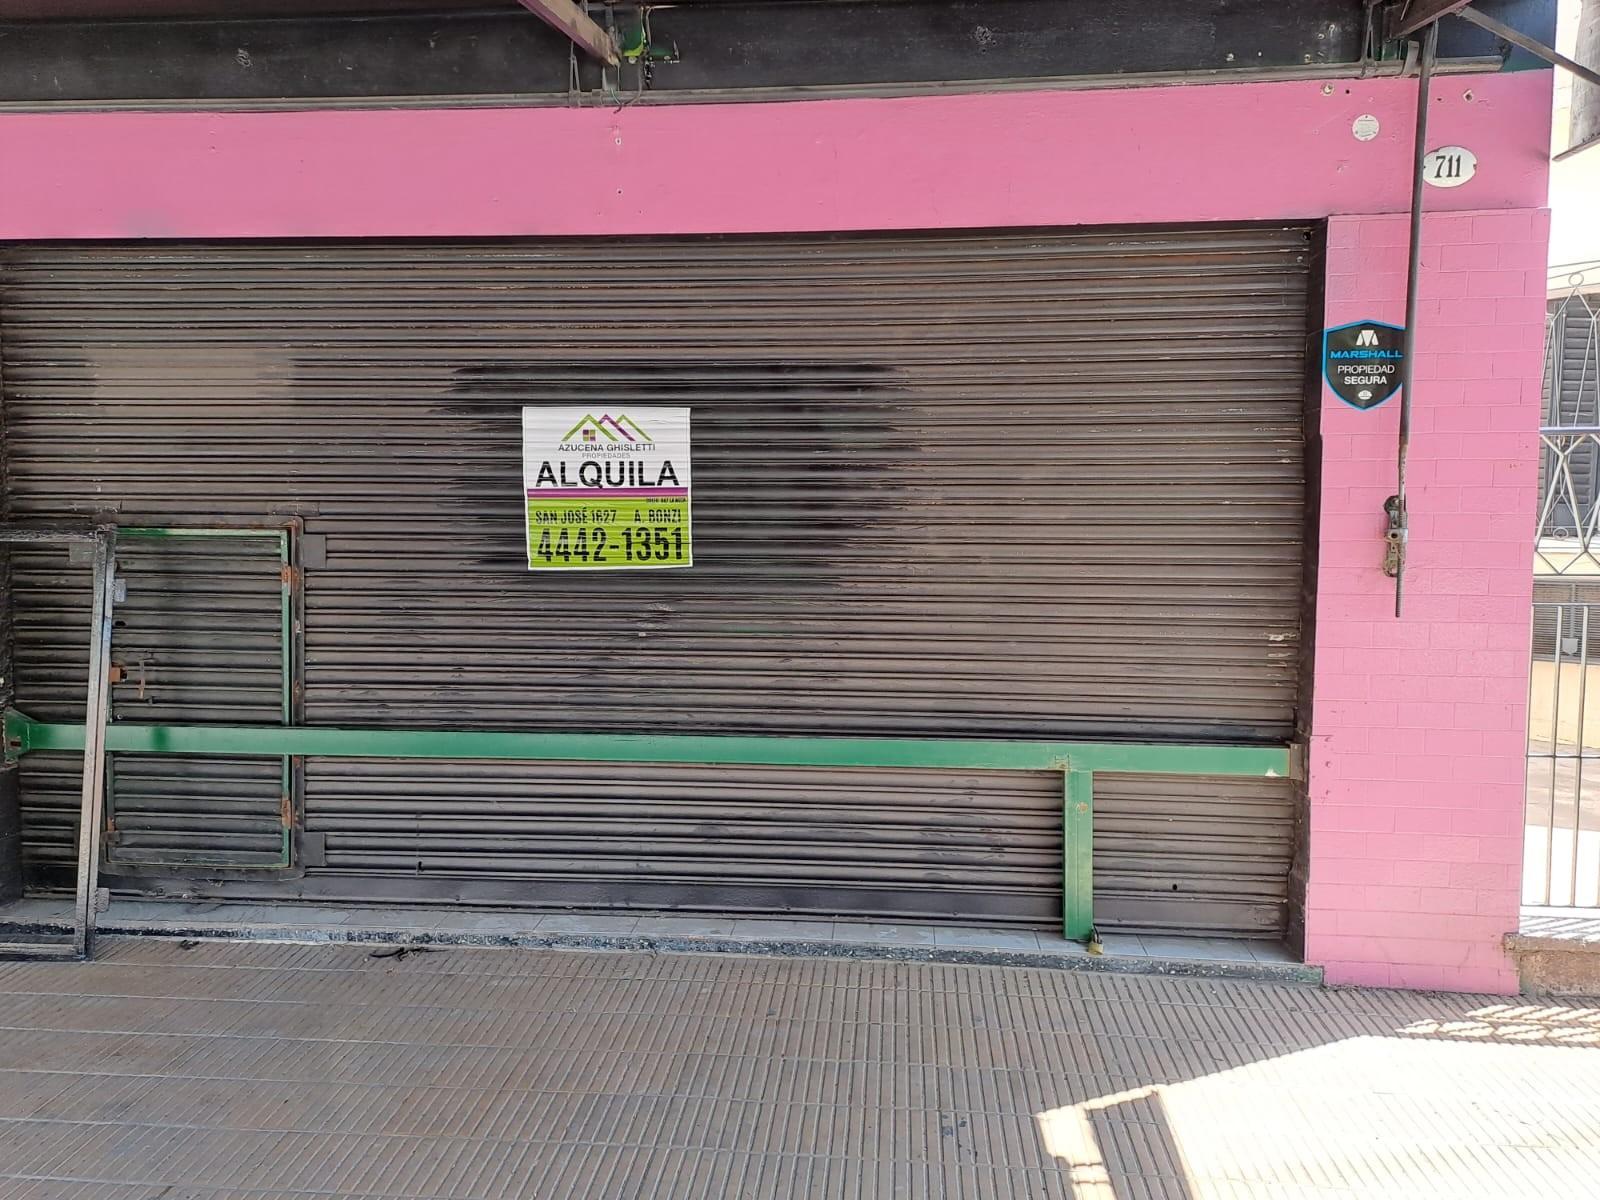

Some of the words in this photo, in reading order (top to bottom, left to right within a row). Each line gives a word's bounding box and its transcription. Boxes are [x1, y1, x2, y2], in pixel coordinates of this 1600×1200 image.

[1434, 155, 1461, 178] 711
[1330, 350, 1403, 359] MARSHALL
[1337, 365, 1395, 374] PROPIEDAD
[1344, 376, 1387, 385] SEGURA
[558, 443, 604, 452] AZUCENA
[606, 443, 656, 452] GHISLETTI
[535, 460, 680, 489] ALQUILA
[535, 510, 558, 524] SAN
[560, 507, 588, 524] JOSÉ
[648, 509, 681, 523] BONZI
[537, 527, 683, 562] 4442-1351
